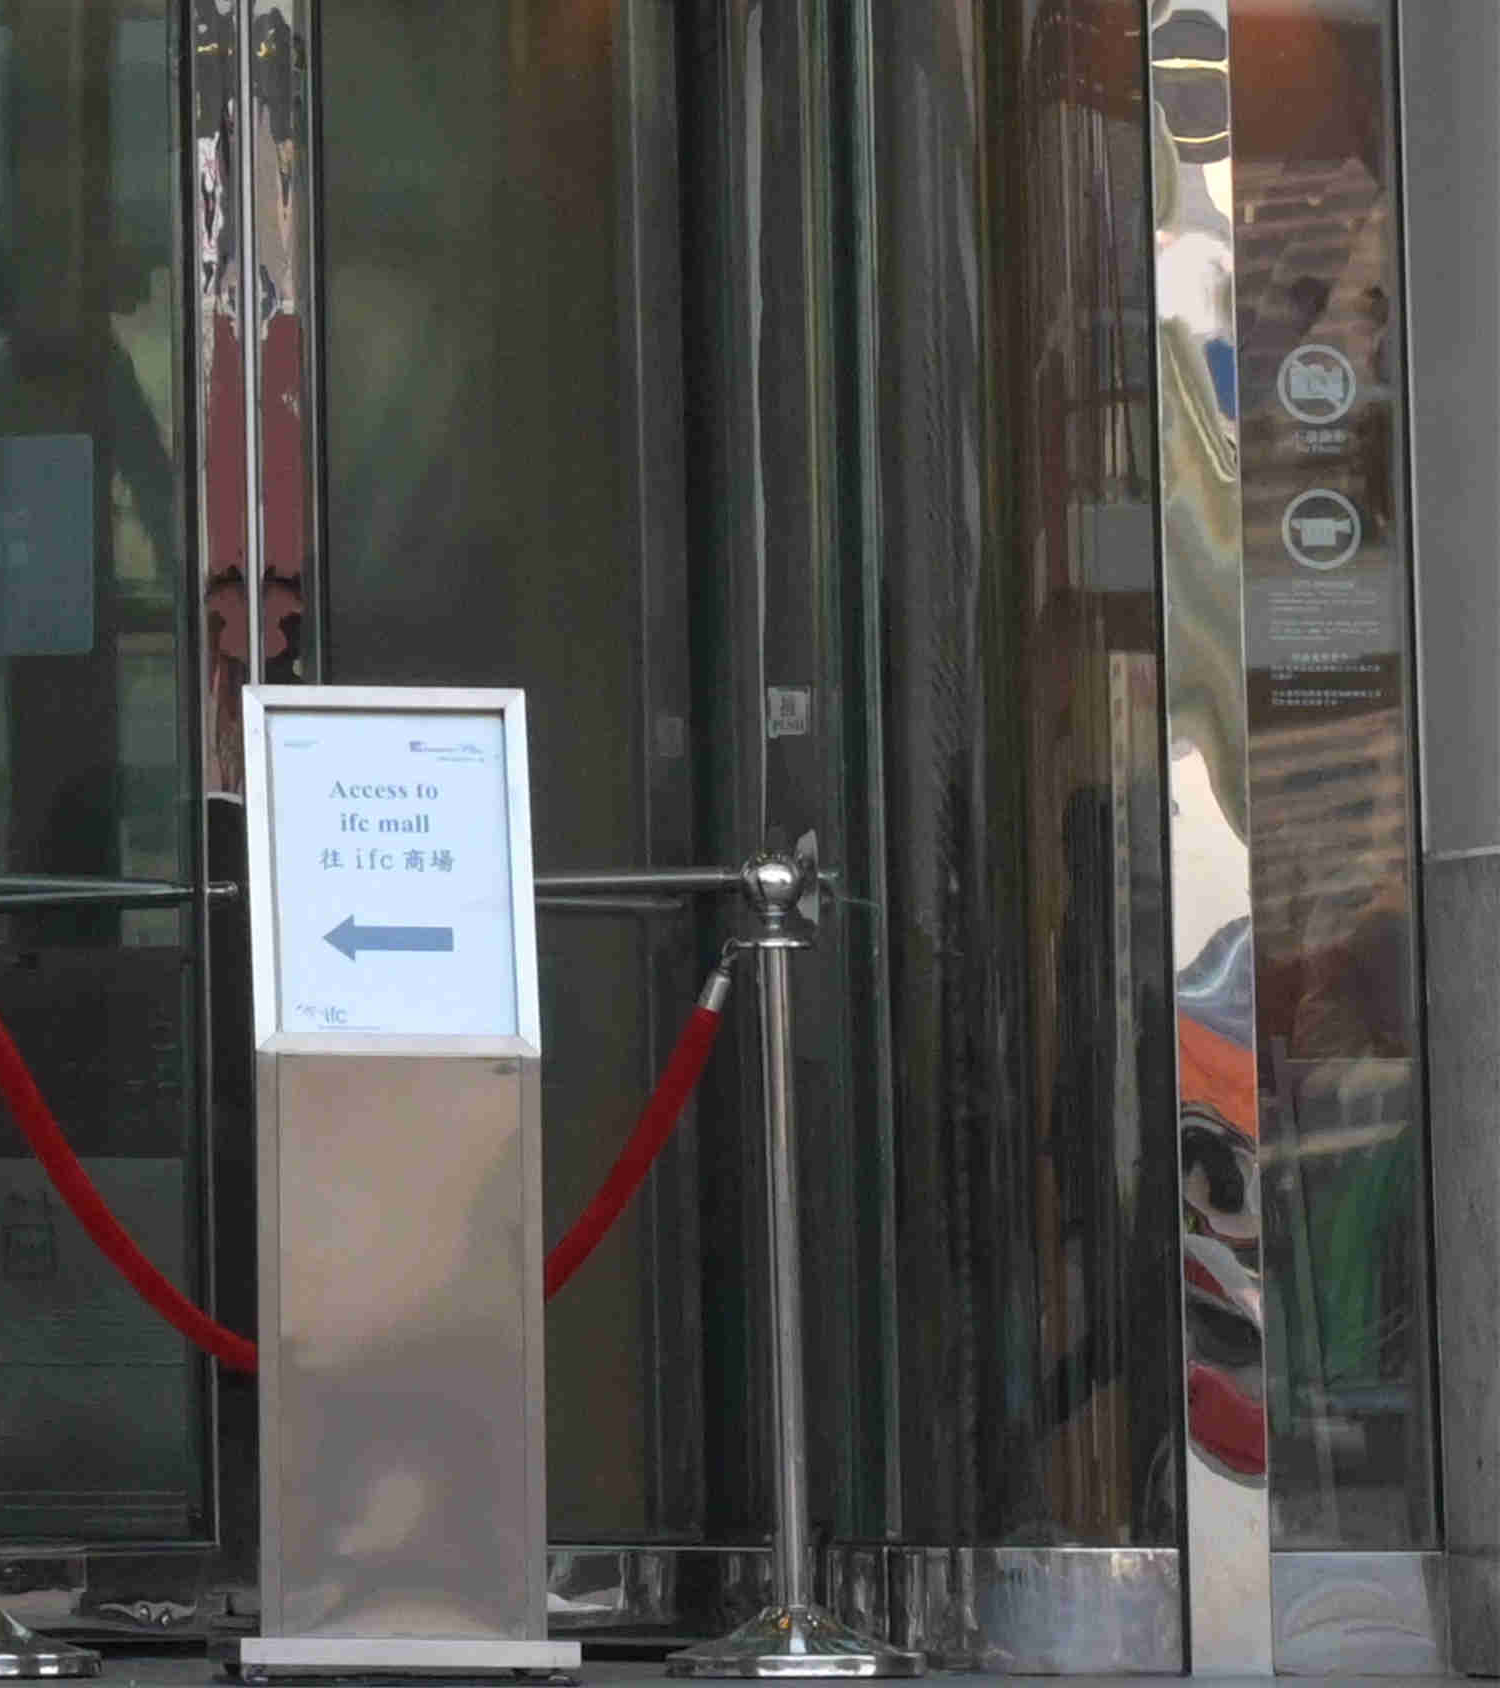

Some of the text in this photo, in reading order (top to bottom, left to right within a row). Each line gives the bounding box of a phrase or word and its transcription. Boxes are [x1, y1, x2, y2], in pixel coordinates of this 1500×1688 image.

[329, 780, 439, 800] Access to
[340, 813, 430, 833] ifc mall
[355, 848, 394, 871] ifc
